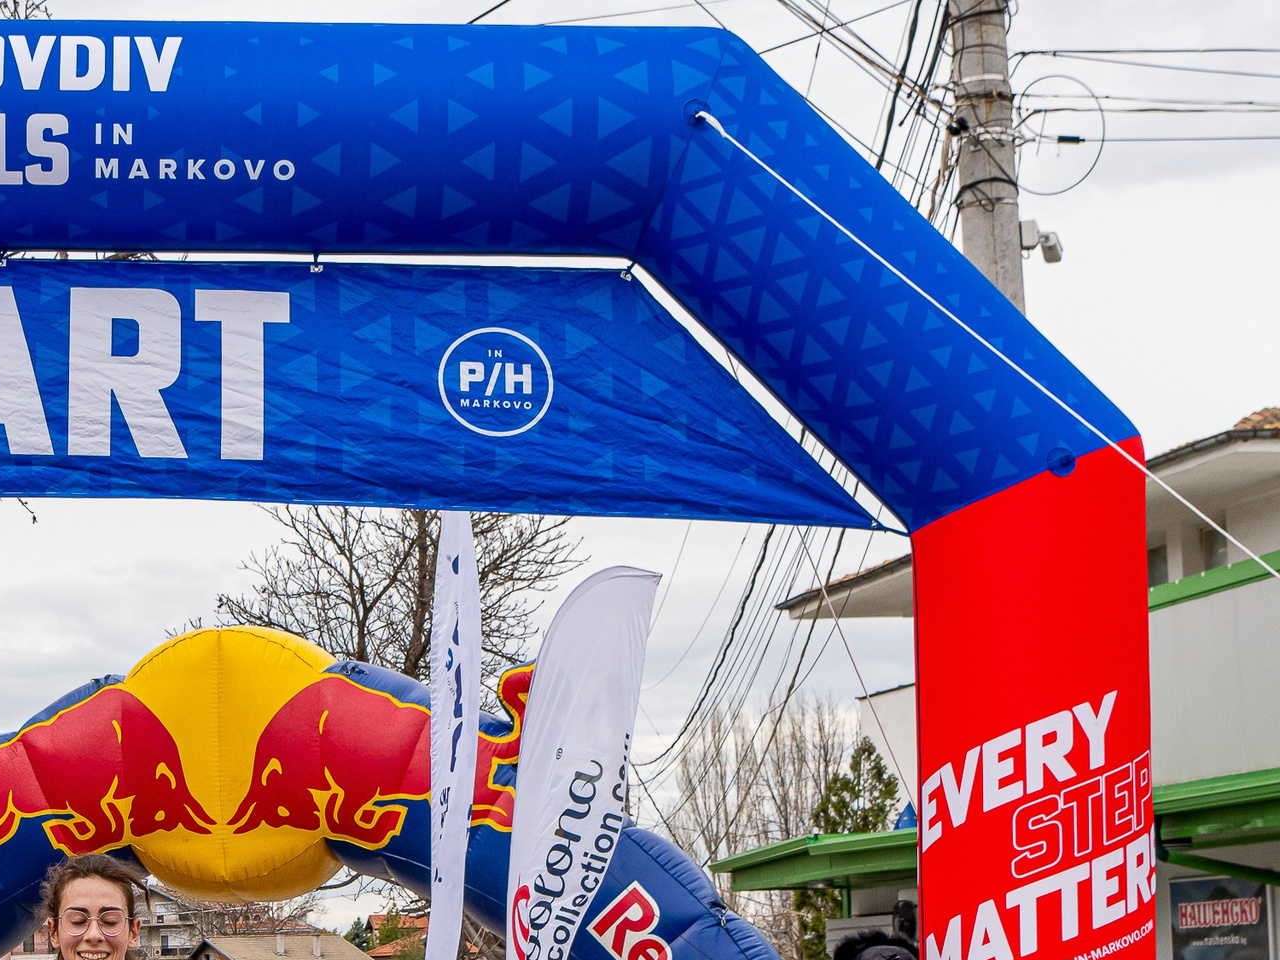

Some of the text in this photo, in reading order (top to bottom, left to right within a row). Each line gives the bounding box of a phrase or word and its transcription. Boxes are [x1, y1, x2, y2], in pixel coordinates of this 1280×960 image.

[94, 123, 133, 145] IN
[94, 158, 296, 181] MARKOVO
[487, 349, 503, 358] IN
[459, 361, 533, 397] P/H
[460, 398, 533, 410] MARKOVO
[922, 690, 1118, 853] EVERY
[1011, 750, 1152, 879] STEP
